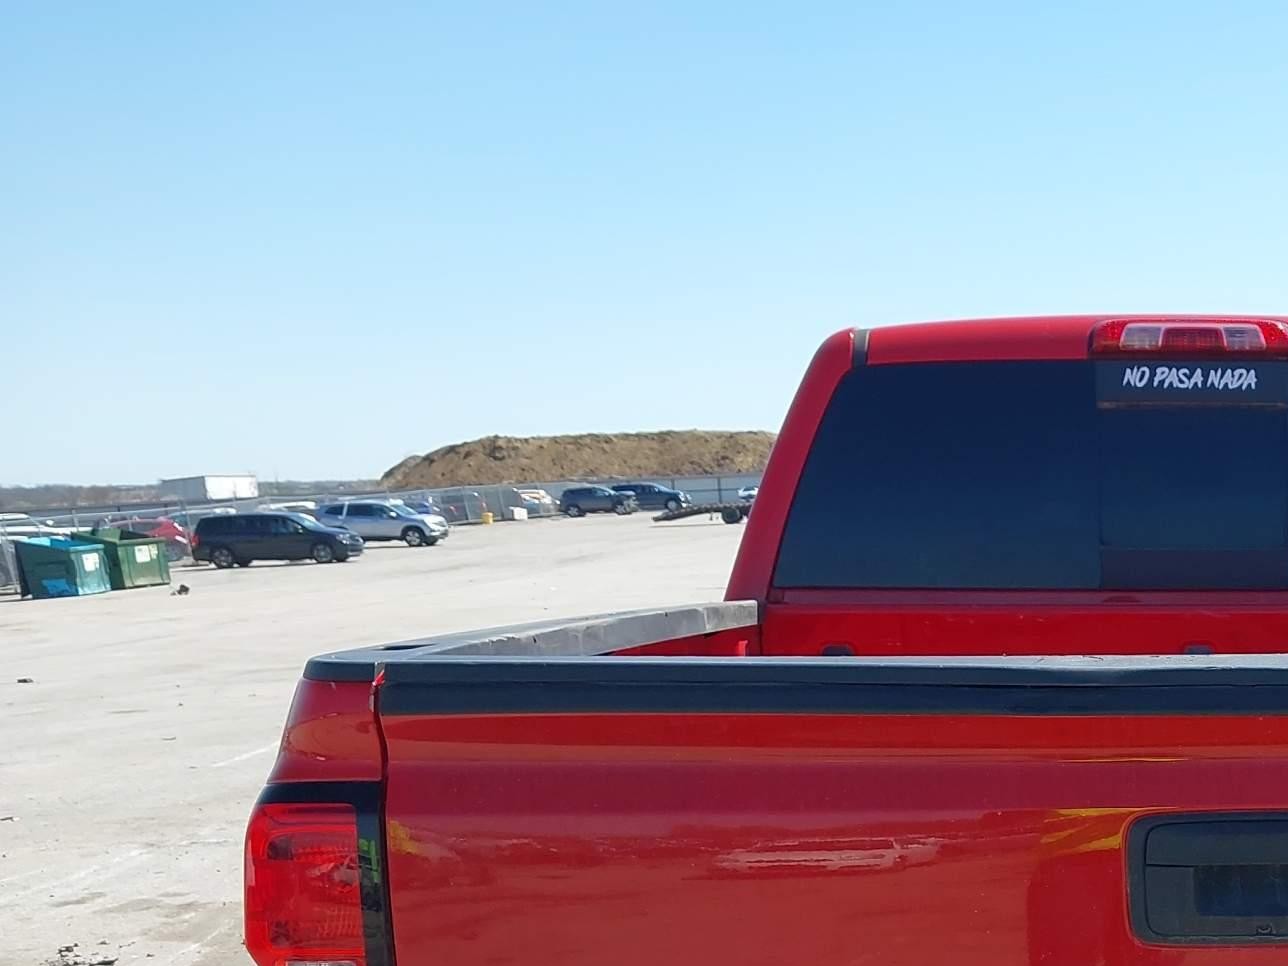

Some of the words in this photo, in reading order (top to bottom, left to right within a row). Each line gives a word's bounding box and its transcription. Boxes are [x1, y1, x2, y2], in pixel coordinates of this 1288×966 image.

[1122, 365, 1150, 388] NO
[1153, 366, 1204, 390] PASA
[1206, 367, 1258, 391] NADA
